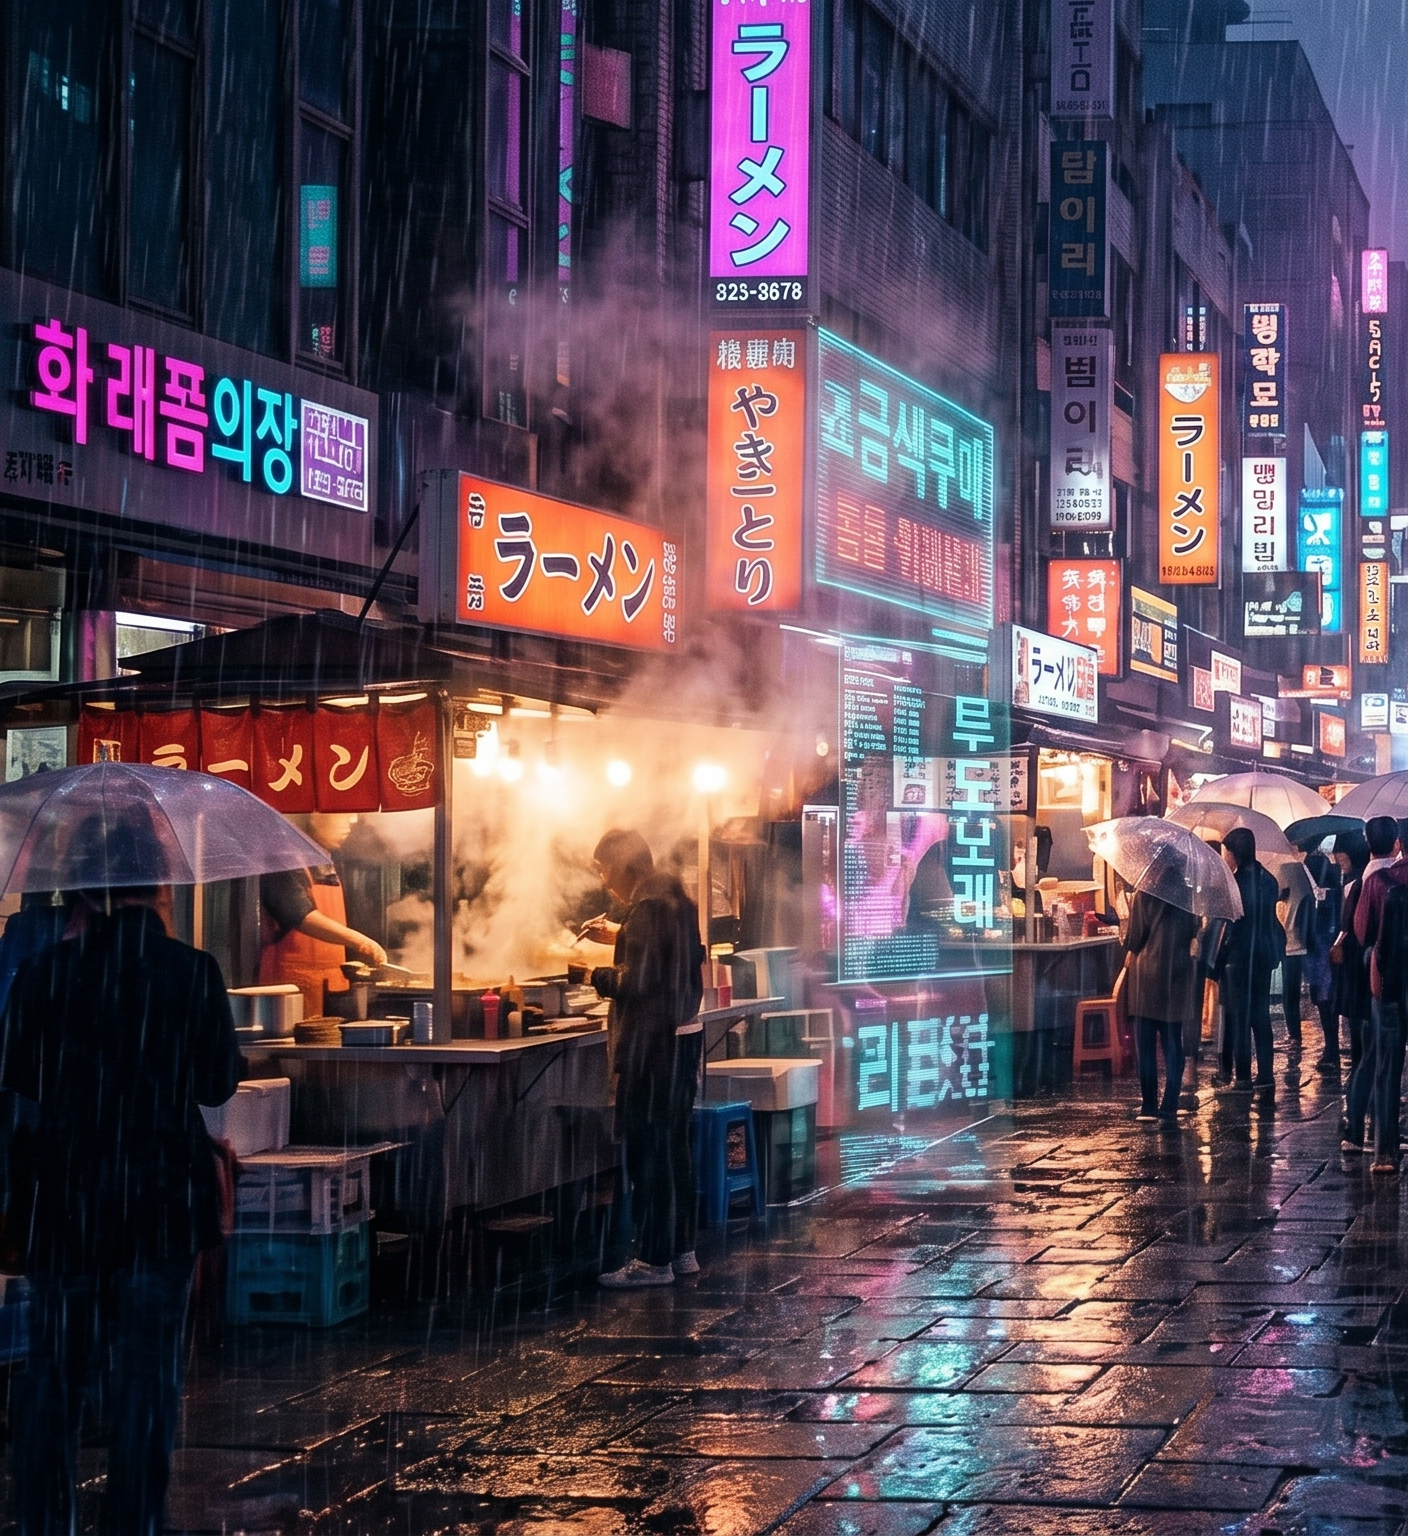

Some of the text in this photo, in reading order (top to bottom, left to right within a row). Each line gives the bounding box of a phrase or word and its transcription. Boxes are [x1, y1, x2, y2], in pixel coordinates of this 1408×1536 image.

[728, 22, 792, 267] ラーメン
[1171, 415, 1204, 556] ラーメン
[494, 512, 655, 623] ラーメン
[153, 743, 369, 791] ラーメン
